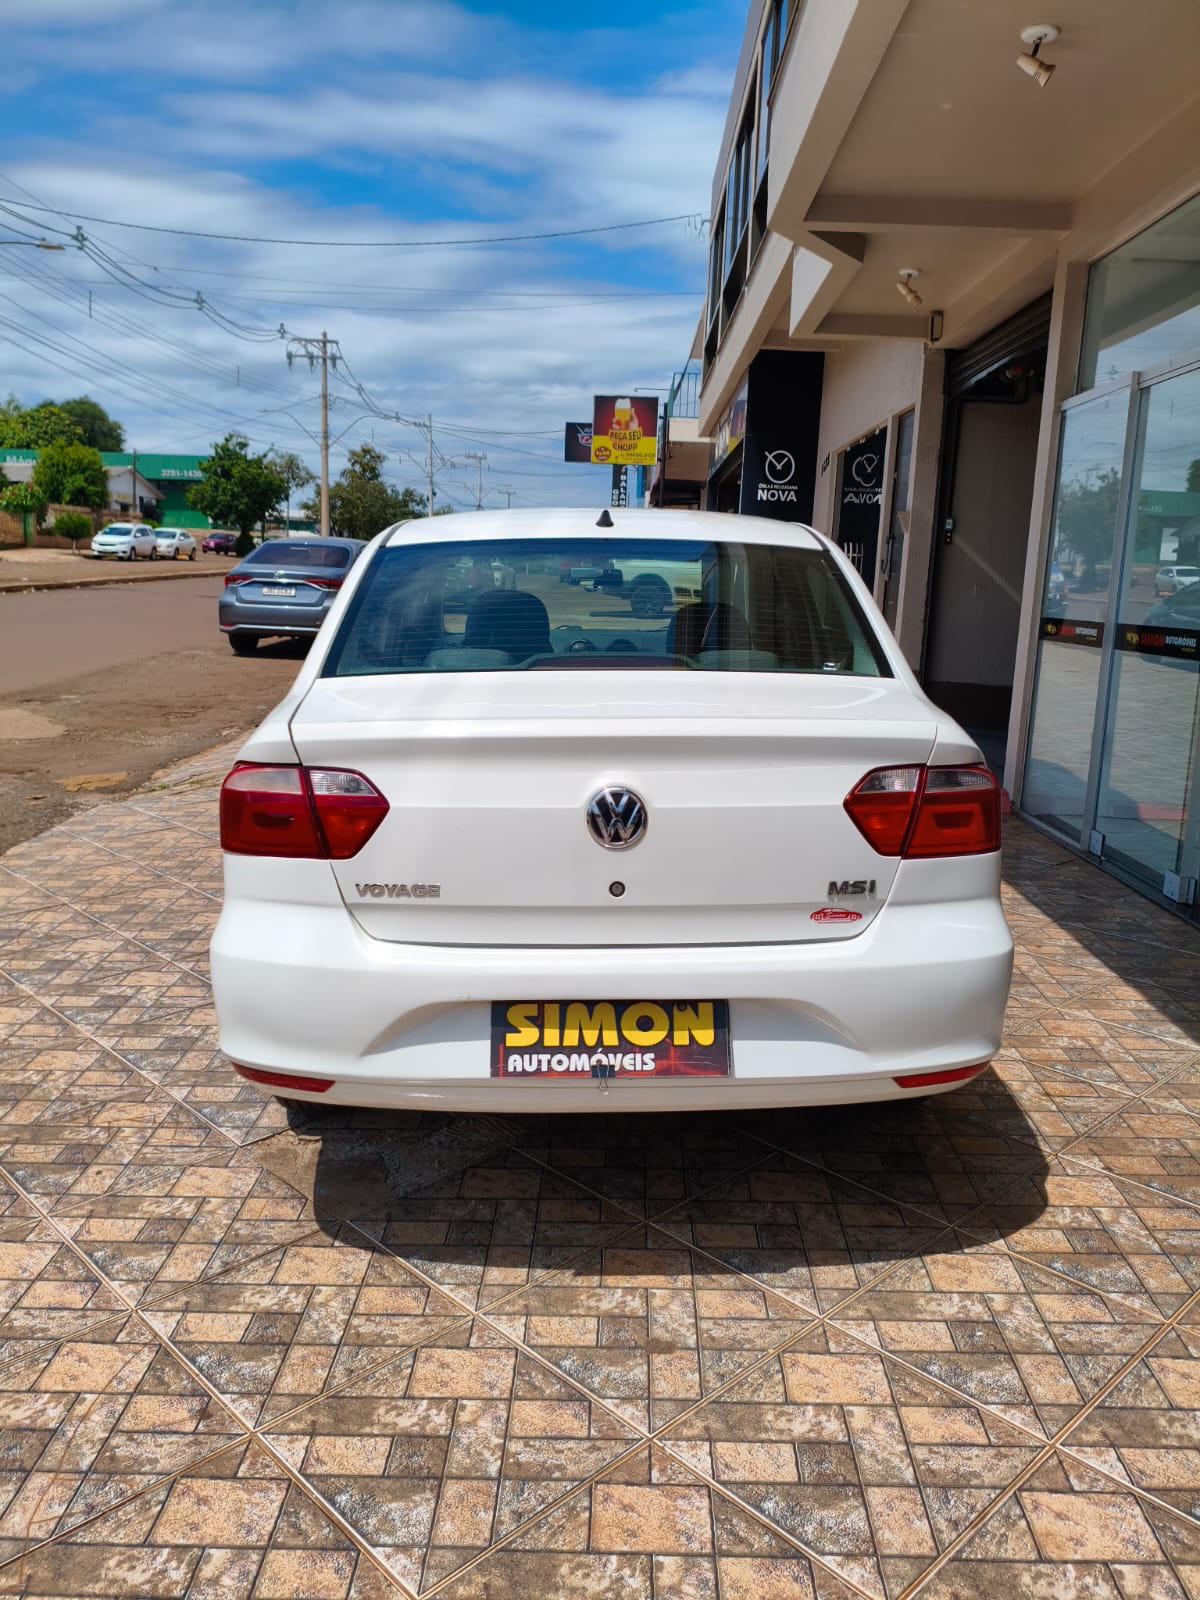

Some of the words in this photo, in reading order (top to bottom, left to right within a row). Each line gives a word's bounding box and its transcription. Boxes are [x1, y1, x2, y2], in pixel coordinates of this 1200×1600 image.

[757, 489, 797, 502] NOVA
[355, 883, 441, 898] VOYAGE
[828, 880, 876, 896] MSI
[505, 1002, 715, 1047] SIMON
[508, 1048, 656, 1073] AUTOMÓVEIS
